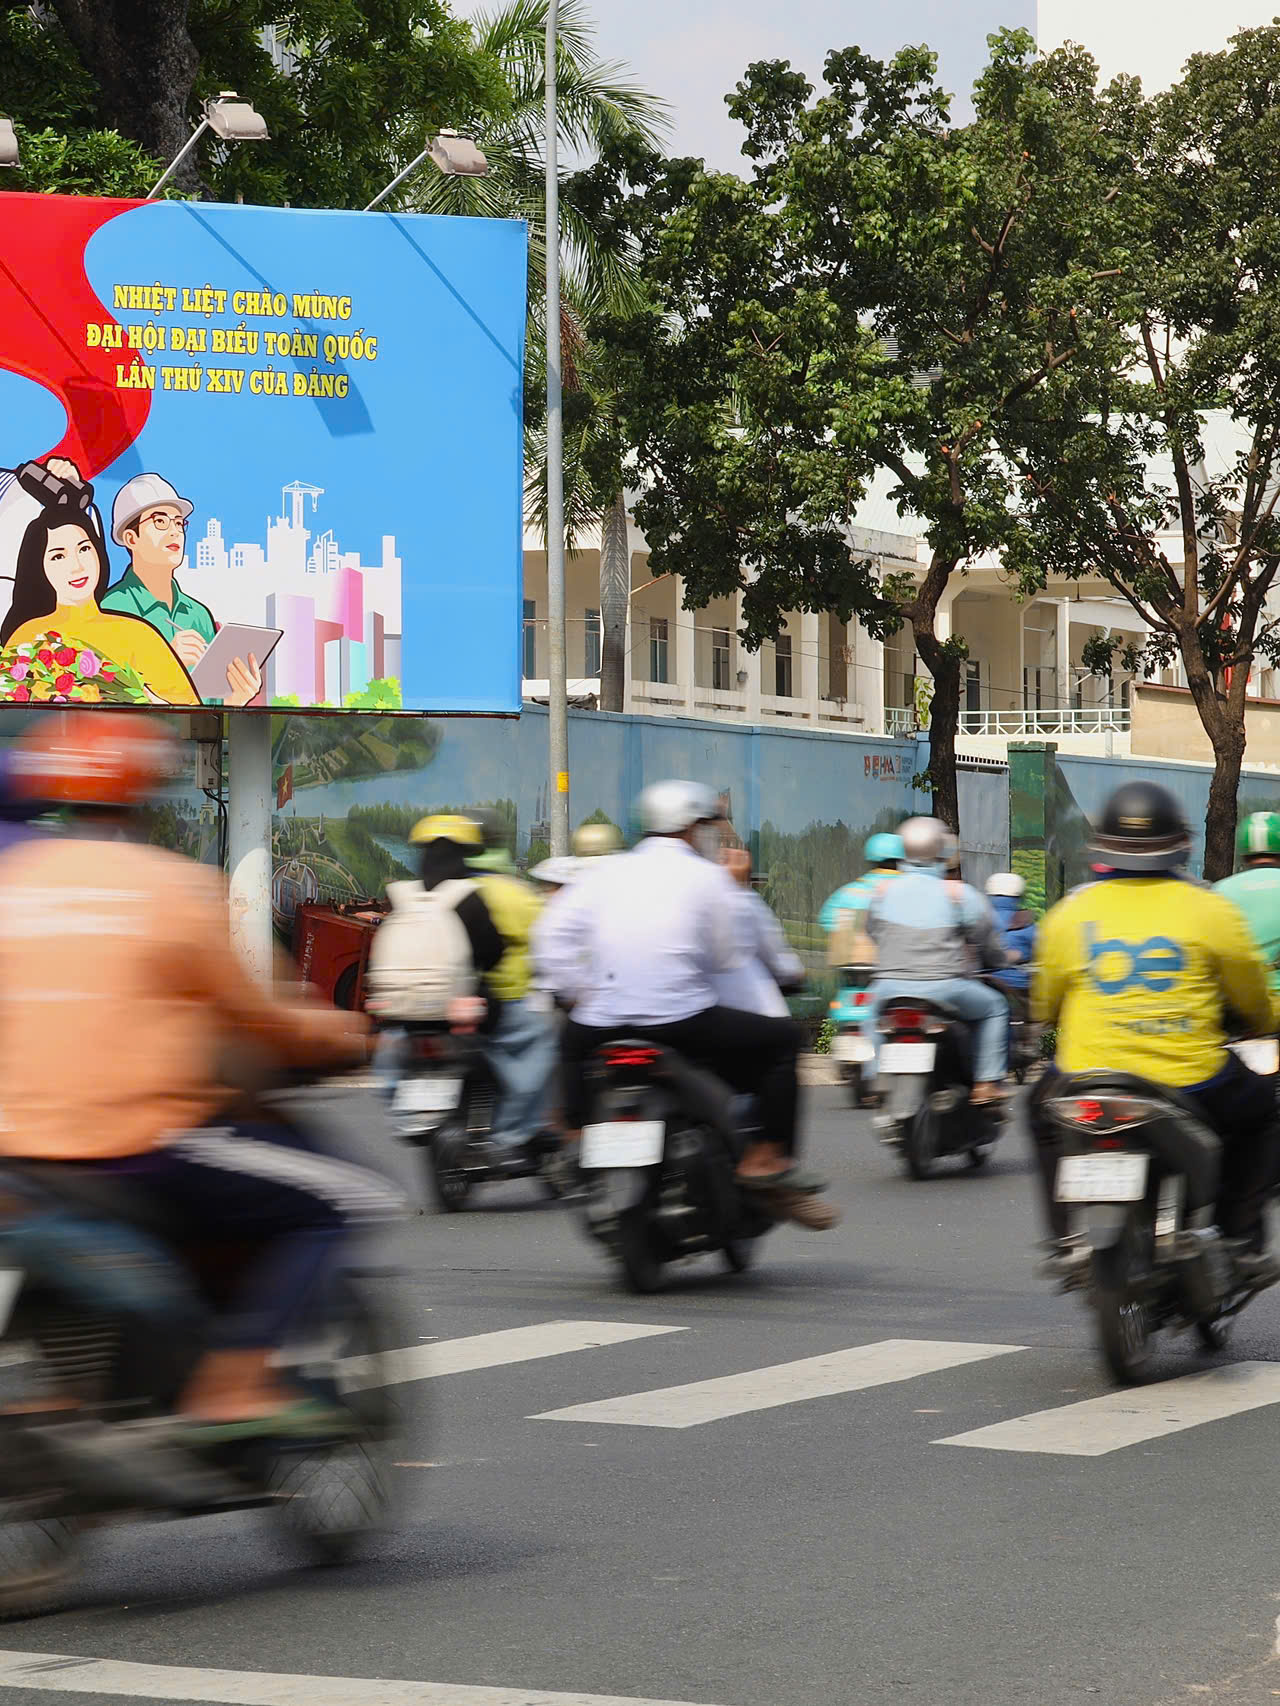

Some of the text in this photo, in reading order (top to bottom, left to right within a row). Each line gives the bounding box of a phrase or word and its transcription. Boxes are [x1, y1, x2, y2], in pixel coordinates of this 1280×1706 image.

[113, 281, 352, 320] NHIỆT LIỆT CHÀO MỪNG
[86, 320, 377, 364] ĐẠI HỘI ĐẠI BIỂU TOÀN QUỐC
[116, 356, 349, 398] LẦN THỨ XIV CỦA ĐẢNG
[1080, 920, 1186, 995] be
